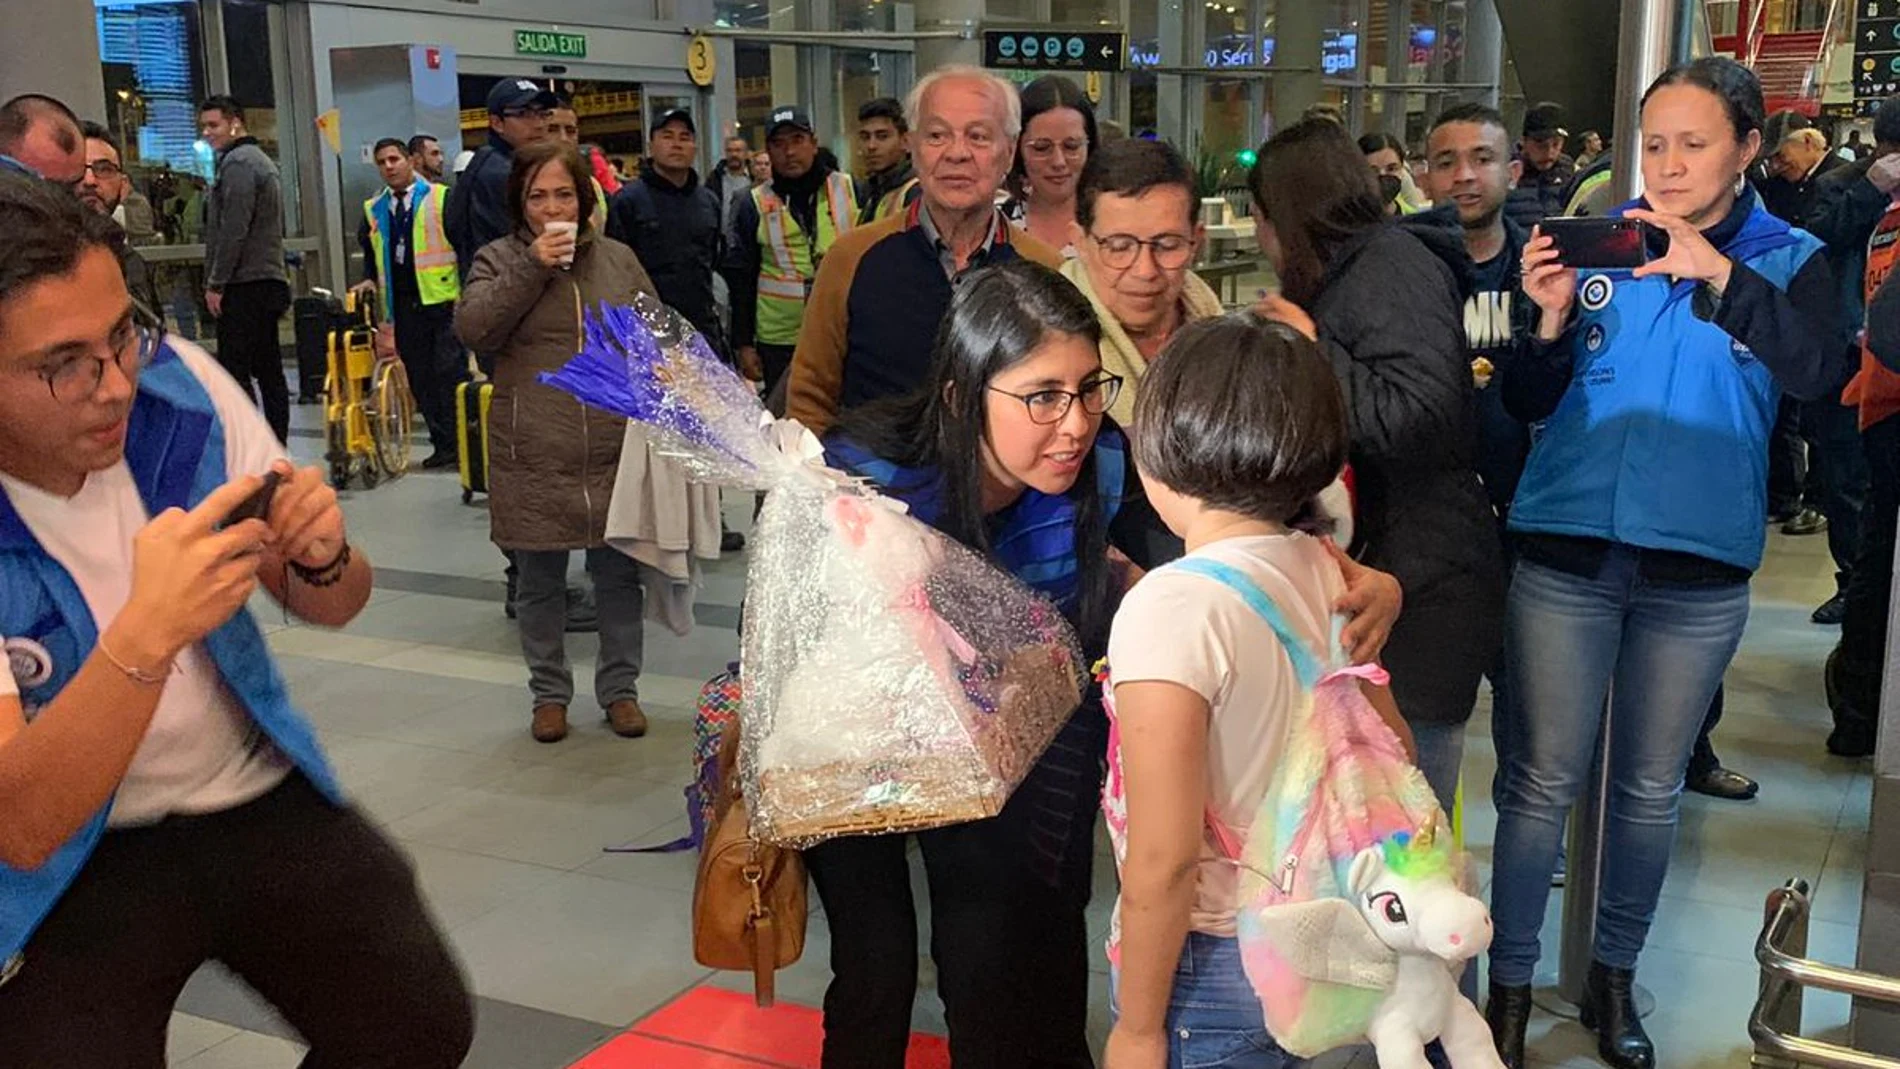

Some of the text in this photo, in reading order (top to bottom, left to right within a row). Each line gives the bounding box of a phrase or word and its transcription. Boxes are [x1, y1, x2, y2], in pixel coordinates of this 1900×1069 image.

[518, 33, 584, 54] SALIDA EXIT
[696, 41, 706, 70] 3
[869, 52, 880, 71] 1
